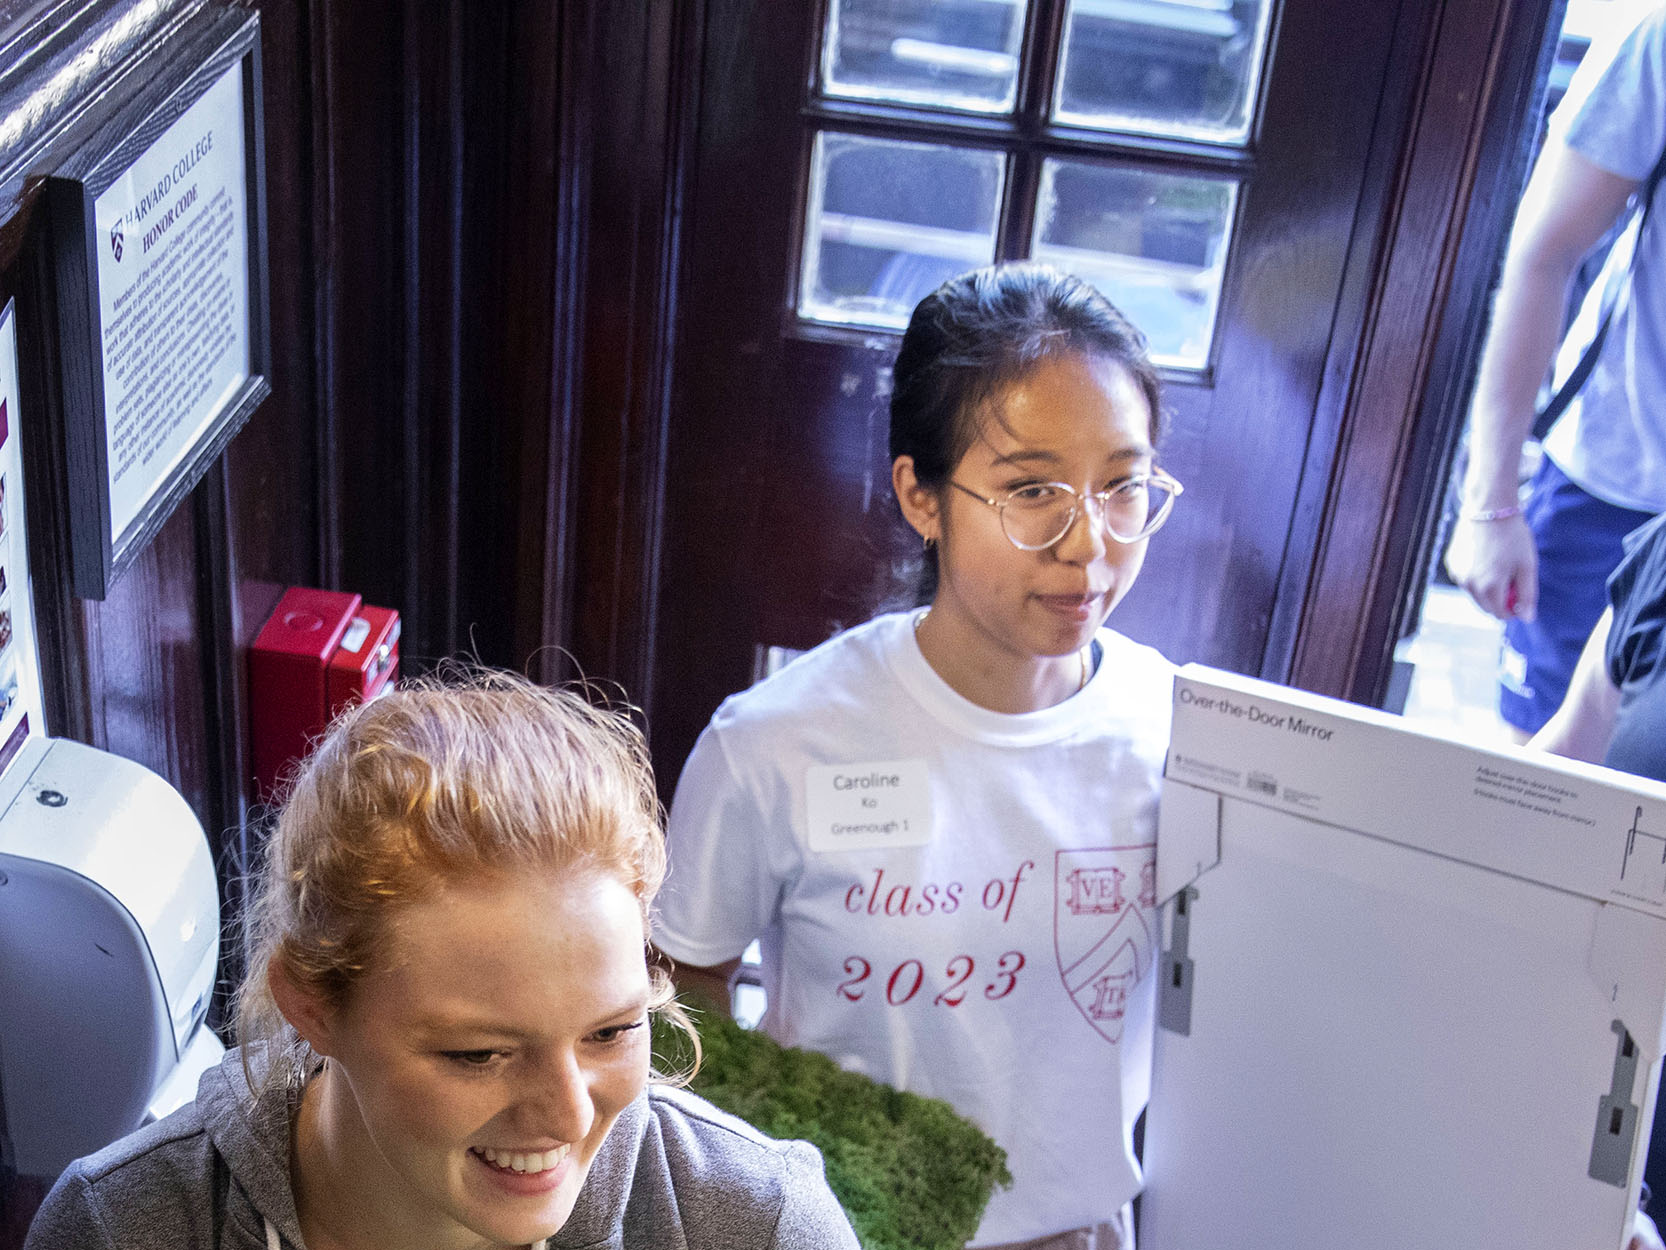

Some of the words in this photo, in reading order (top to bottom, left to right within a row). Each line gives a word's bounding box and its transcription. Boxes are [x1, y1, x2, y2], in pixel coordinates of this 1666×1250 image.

[125, 174, 172, 225] HARVARD
[172, 130, 214, 185] COLLEGE
[142, 209, 174, 254] HONOR
[175, 183, 199, 219] CODE
[1179, 687, 1285, 728] Over-the-Door
[1288, 715, 1335, 741] Mirror
[833, 772, 900, 791] Caroline
[861, 797, 878, 809] Ko
[831, 821, 898, 835] Greenough
[844, 868, 964, 917] class
[982, 860, 1034, 923] of
[1082, 878, 1114, 898] VE
[836, 950, 1026, 1007] 2023
